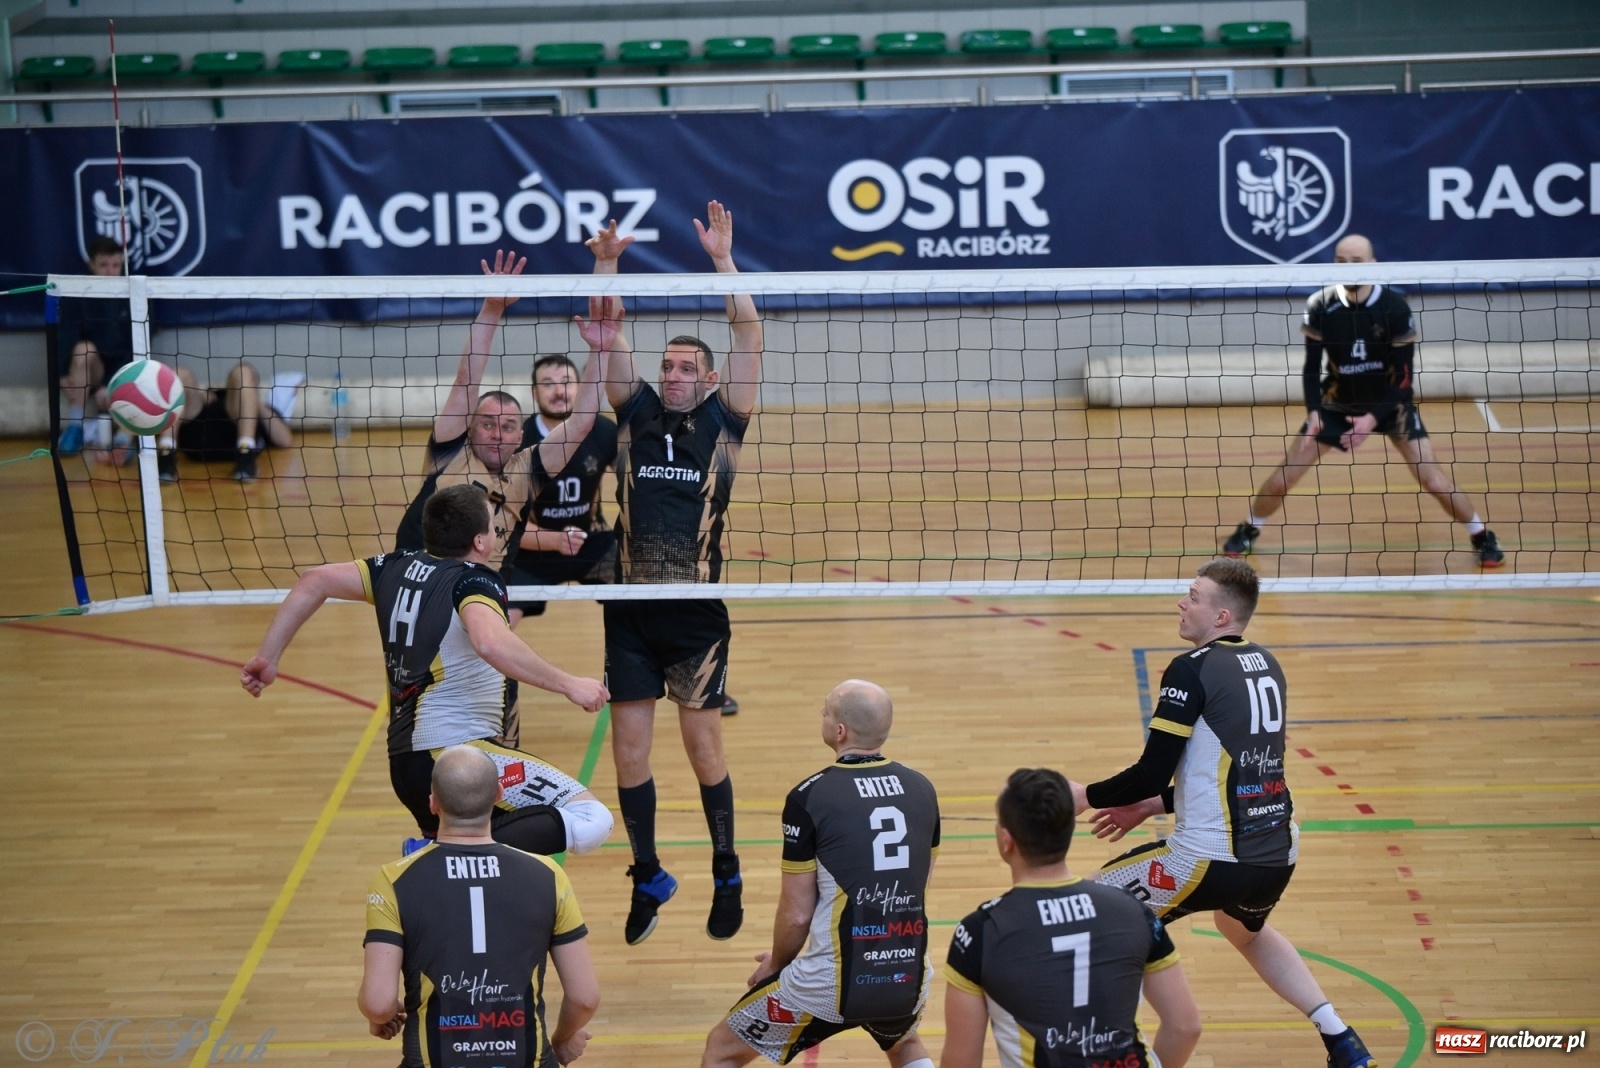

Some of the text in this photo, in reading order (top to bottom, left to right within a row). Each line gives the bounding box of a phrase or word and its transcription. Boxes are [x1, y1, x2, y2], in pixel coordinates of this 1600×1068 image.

[1429, 162, 1600, 222] RACI
[279, 172, 659, 249] RACIBÓRZ
[918, 229, 1051, 258] RACIBÓRZ
[1350, 339, 1368, 361] 4
[664, 433, 674, 462] 1
[638, 465, 701, 483] AGROTIM
[557, 476, 582, 504] 10
[1236, 653, 1268, 673] ENTER
[1245, 676, 1283, 735] 10
[520, 776, 559, 802] 14
[853, 775, 904, 798] ENTER
[869, 806, 910, 872] 2
[445, 855, 501, 880] ENTER
[880, 880, 916, 916] Hair
[1036, 893, 1097, 926] ENTER
[469, 886, 487, 954] 1
[851, 919, 924, 937] INSTALMAG
[863, 947, 916, 961] GRAVTON
[1051, 931, 1091, 1008] 7
[467, 968, 509, 1005] Hair
[439, 1010, 526, 1029] INSTALMAG
[746, 1019, 769, 1040] 2
[452, 1040, 517, 1052] GRAVTON
[1077, 1016, 1120, 1057] Hair
